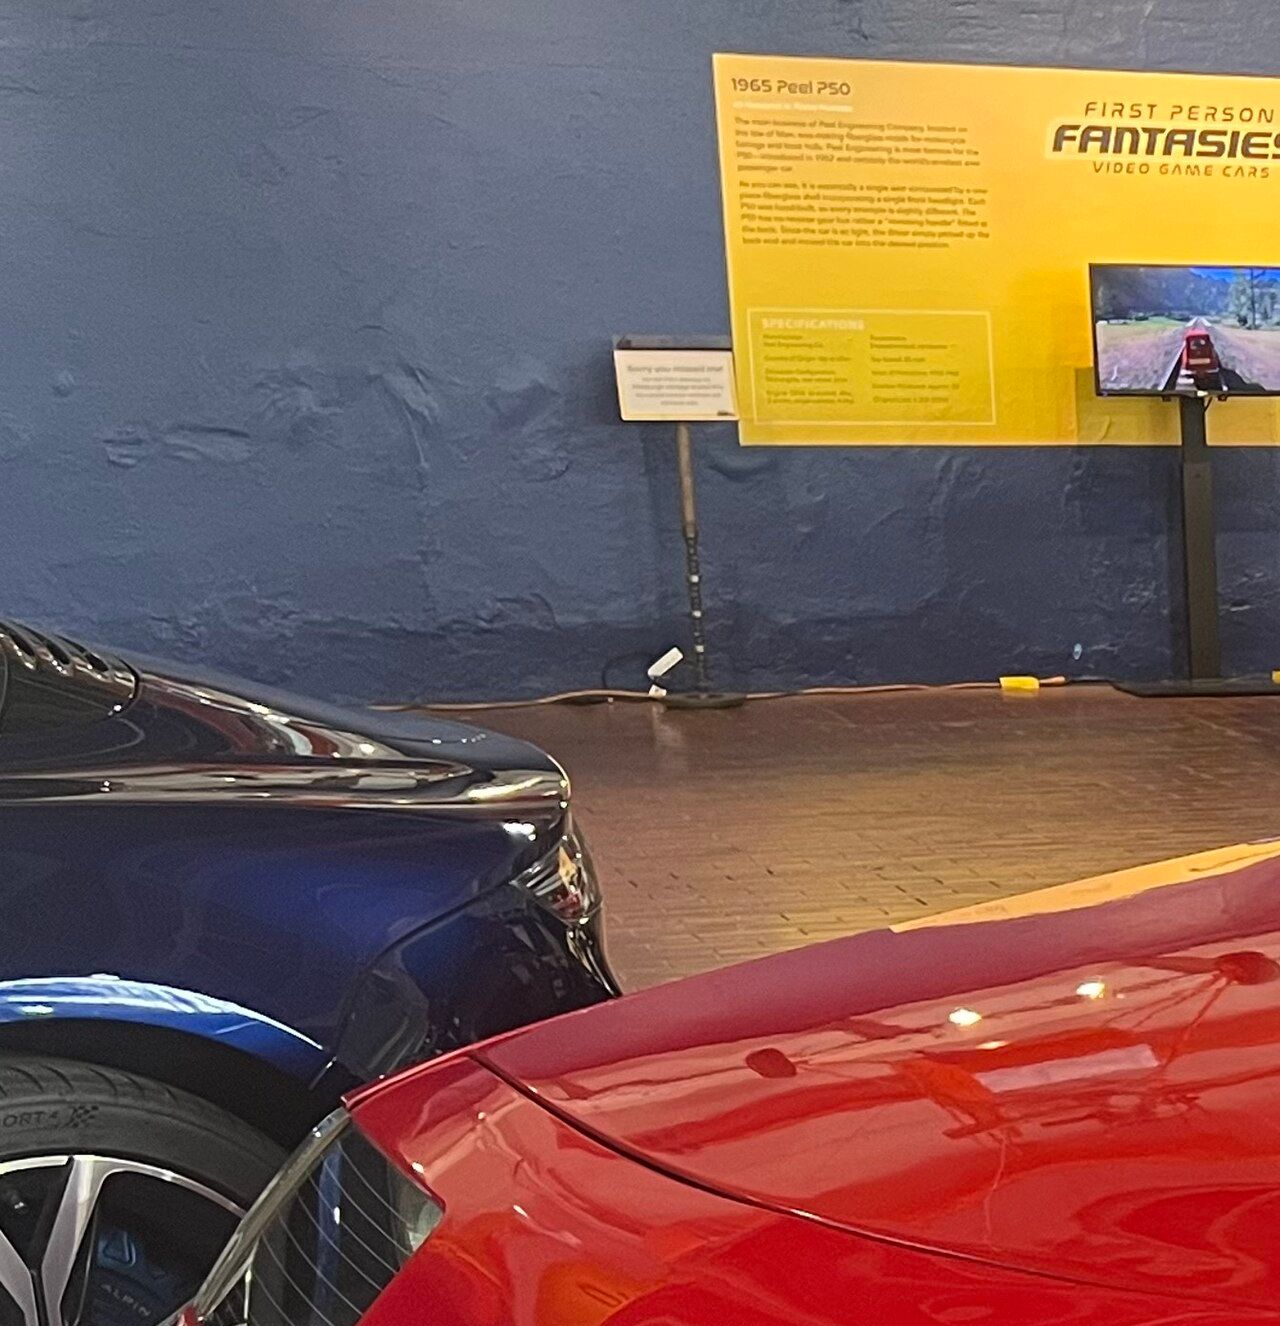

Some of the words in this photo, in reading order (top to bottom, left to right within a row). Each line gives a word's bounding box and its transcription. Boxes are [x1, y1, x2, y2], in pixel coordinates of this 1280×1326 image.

[731, 77, 773, 93] 1965
[776, 80, 814, 95] Peel
[816, 81, 851, 96] P50
[1085, 101, 1158, 120] FIRST
[1170, 104, 1275, 124] PERSON
[1093, 160, 1150, 175] VIDEO
[1158, 163, 1214, 177] GAME
[1222, 165, 1270, 179] CARS
[2, 1111, 45, 1128] ORT
